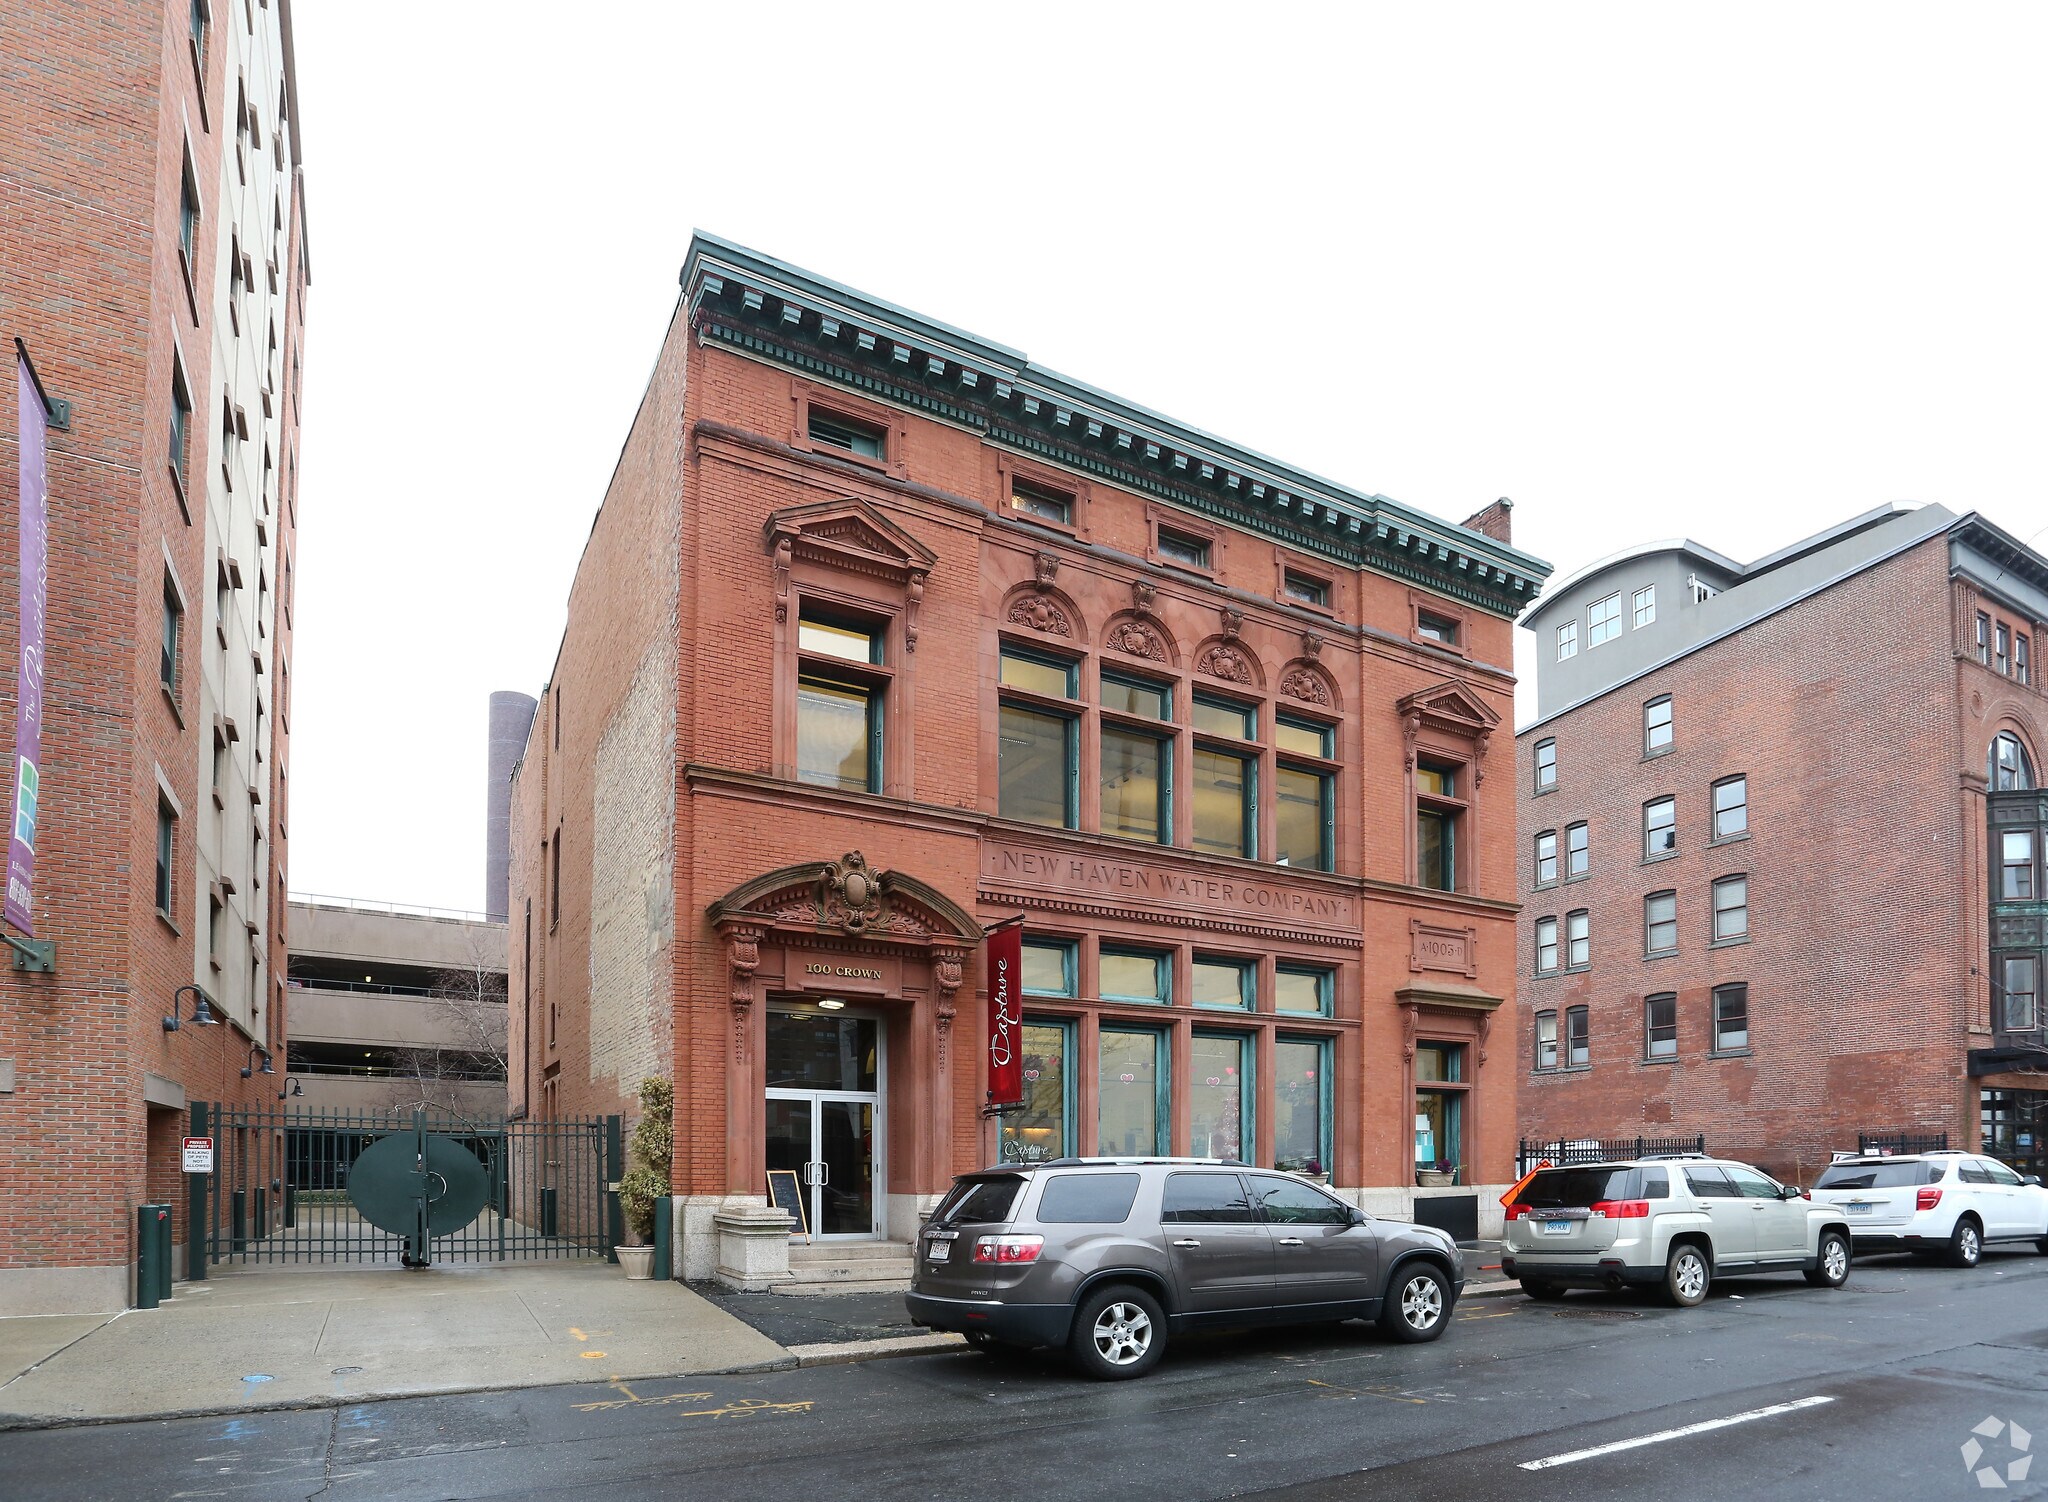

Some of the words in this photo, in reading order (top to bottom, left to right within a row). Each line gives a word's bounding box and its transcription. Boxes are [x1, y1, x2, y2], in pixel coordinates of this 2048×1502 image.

[1003, 850, 1060, 878] NEW
[1069, 860, 1150, 890] HAVEN
[1158, 873, 1233, 902] WATER
[1242, 887, 1342, 917] COMPANY
[806, 963, 832, 975] 100
[836, 966, 882, 980] CROWN
[989, 957, 1020, 1069] Capture
[1004, 1139, 1049, 1158] Capture
